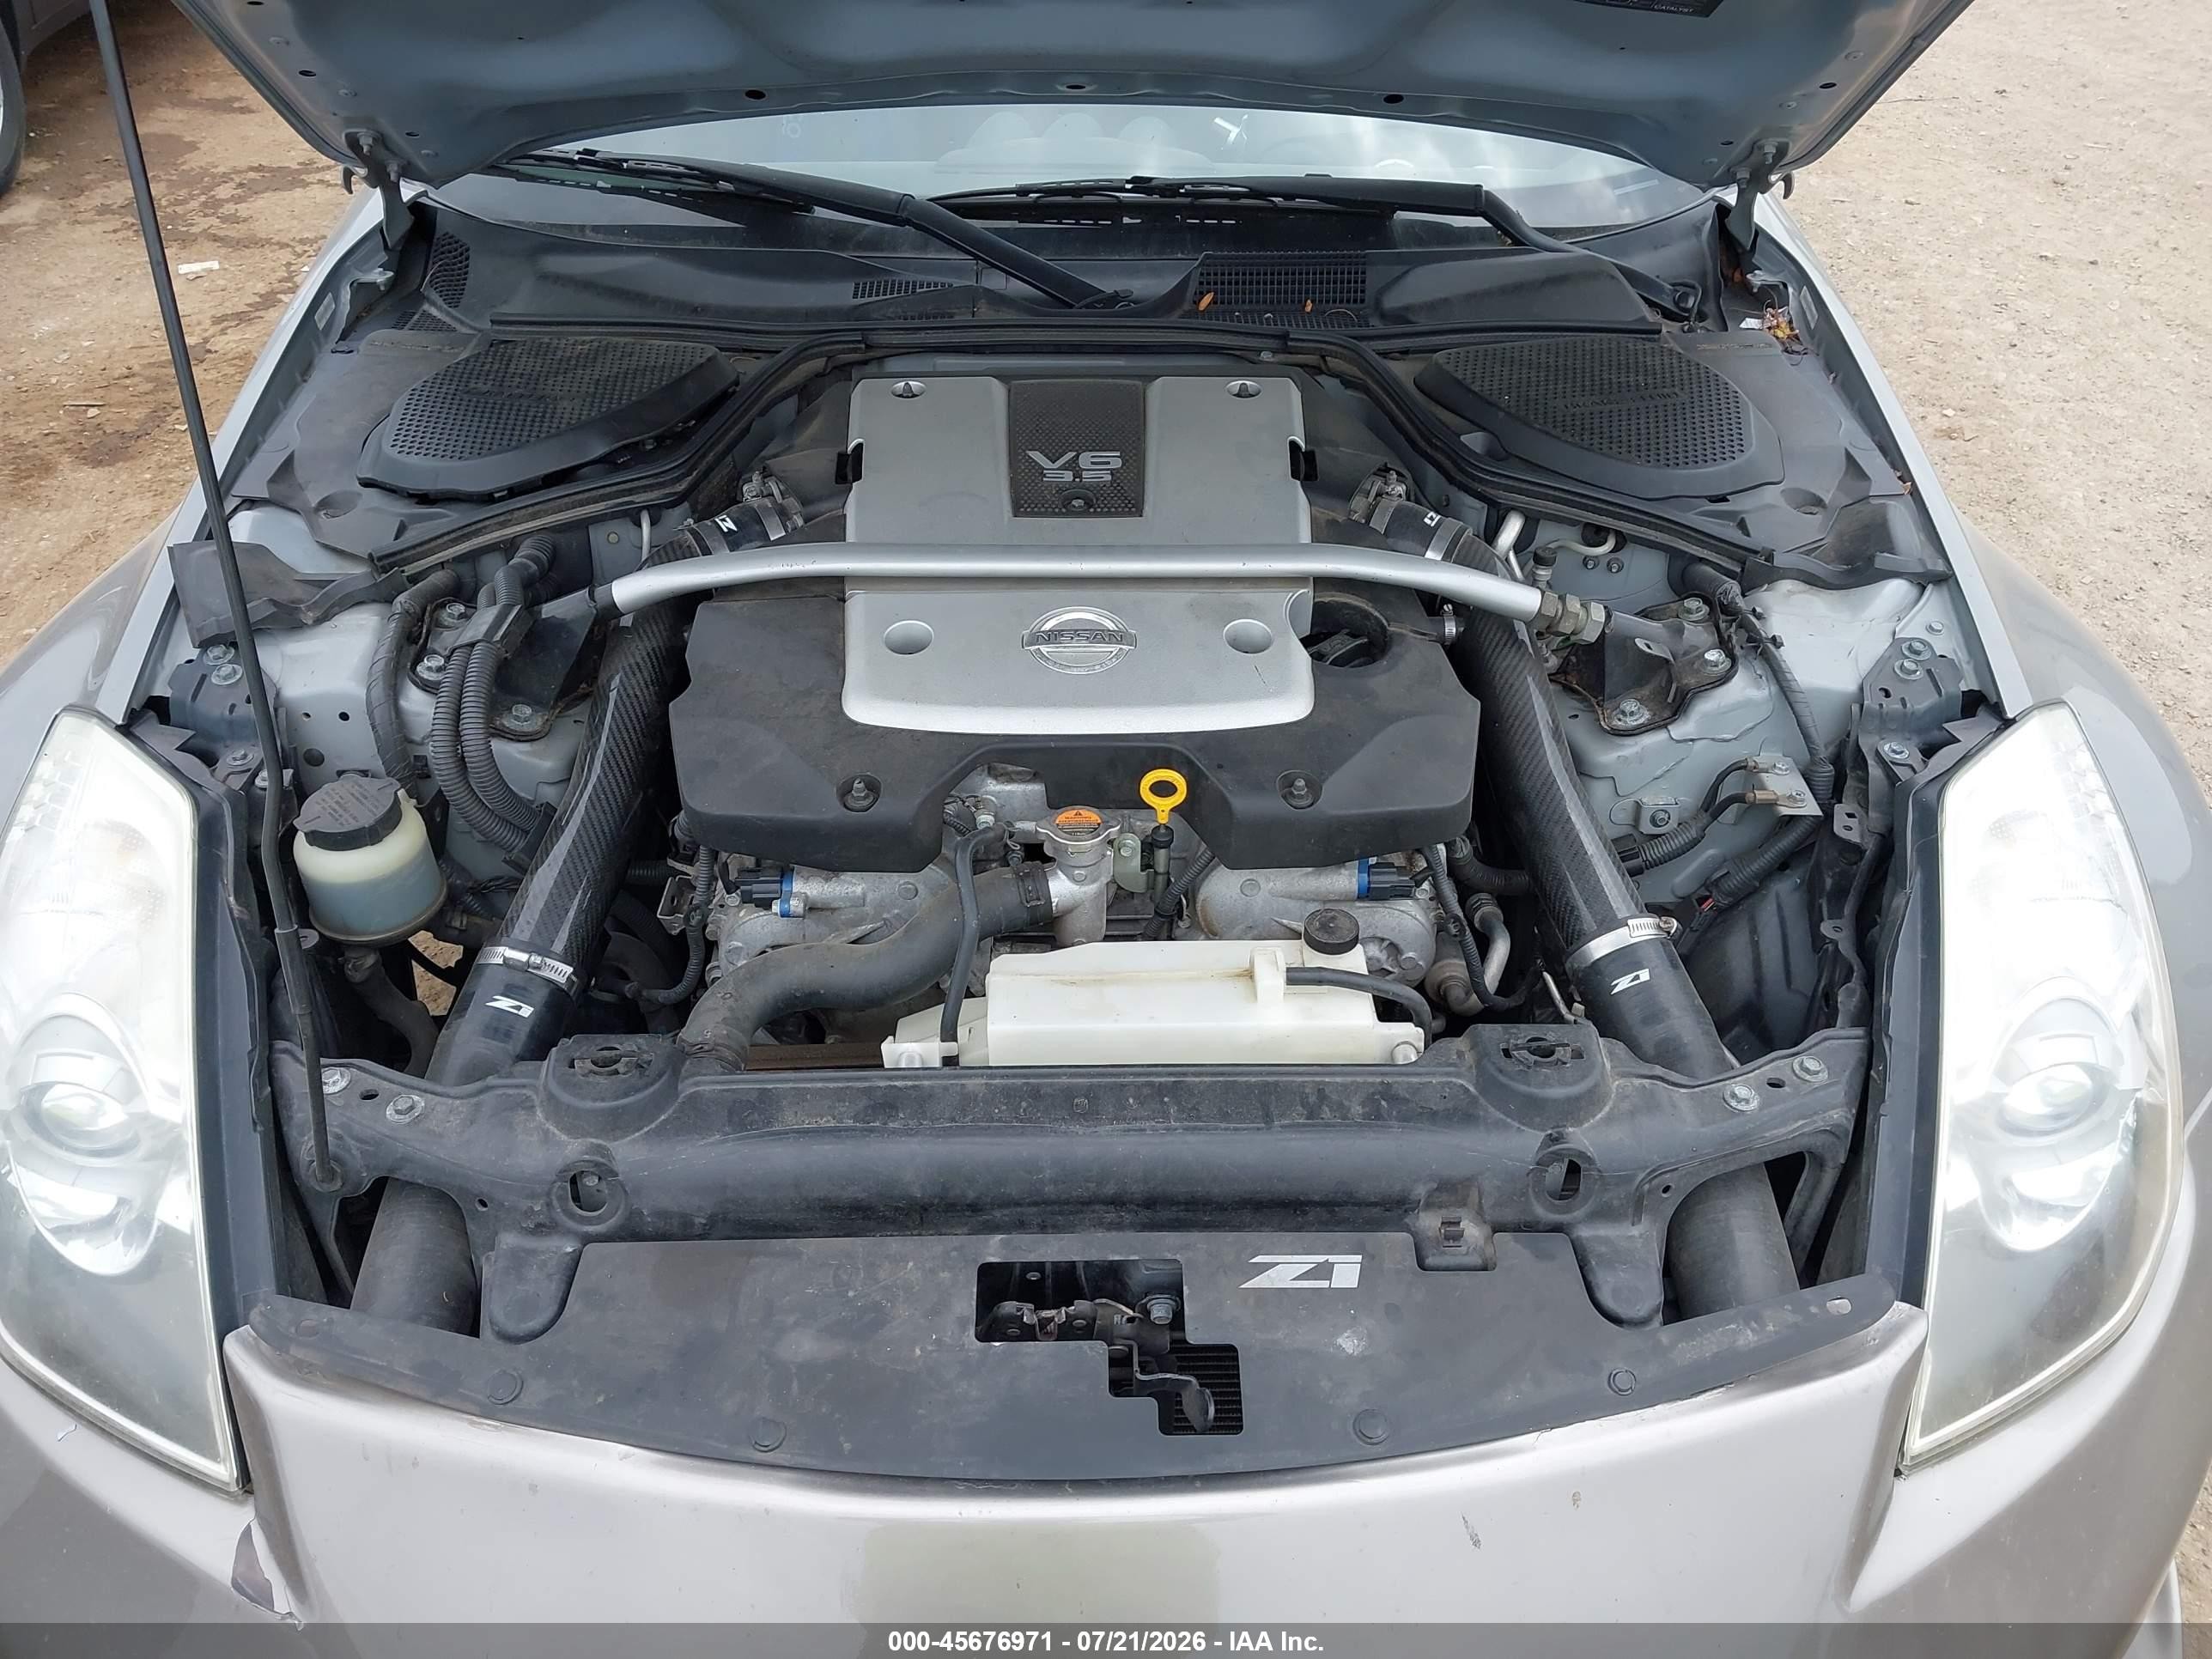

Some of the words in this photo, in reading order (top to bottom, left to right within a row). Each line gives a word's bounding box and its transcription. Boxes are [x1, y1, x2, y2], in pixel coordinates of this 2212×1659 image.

[1025, 450, 1122, 469] V6
[1042, 470, 1112, 482] 3.5
[1035, 630, 1124, 643] NISSAN
